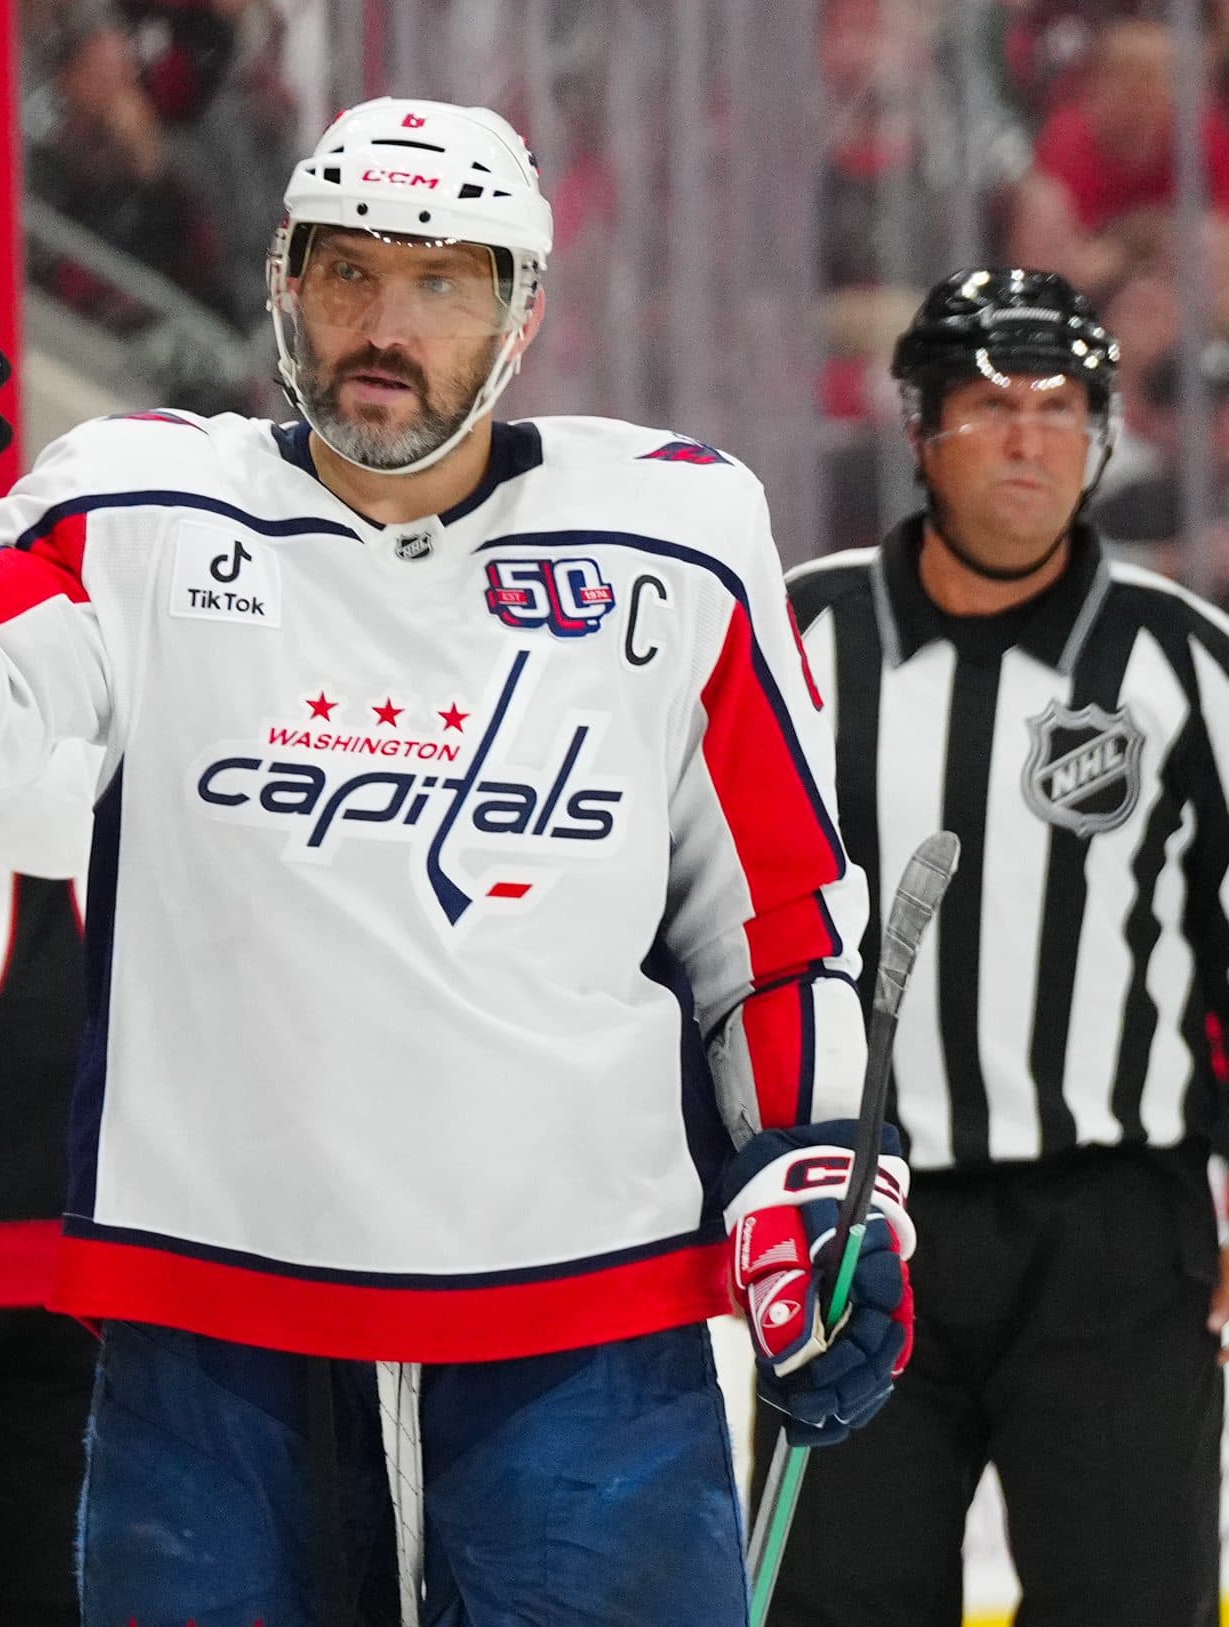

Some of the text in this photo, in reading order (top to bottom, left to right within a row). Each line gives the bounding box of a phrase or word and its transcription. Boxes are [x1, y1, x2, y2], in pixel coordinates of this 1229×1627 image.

[362, 169, 439, 189] CCM
[187, 588, 265, 616] TikTok
[490, 558, 611, 628] 50
[626, 574, 667, 666] C
[268, 727, 460, 762] WASHINGTON
[1051, 737, 1124, 801] NHL
[197, 650, 623, 927] capitals
